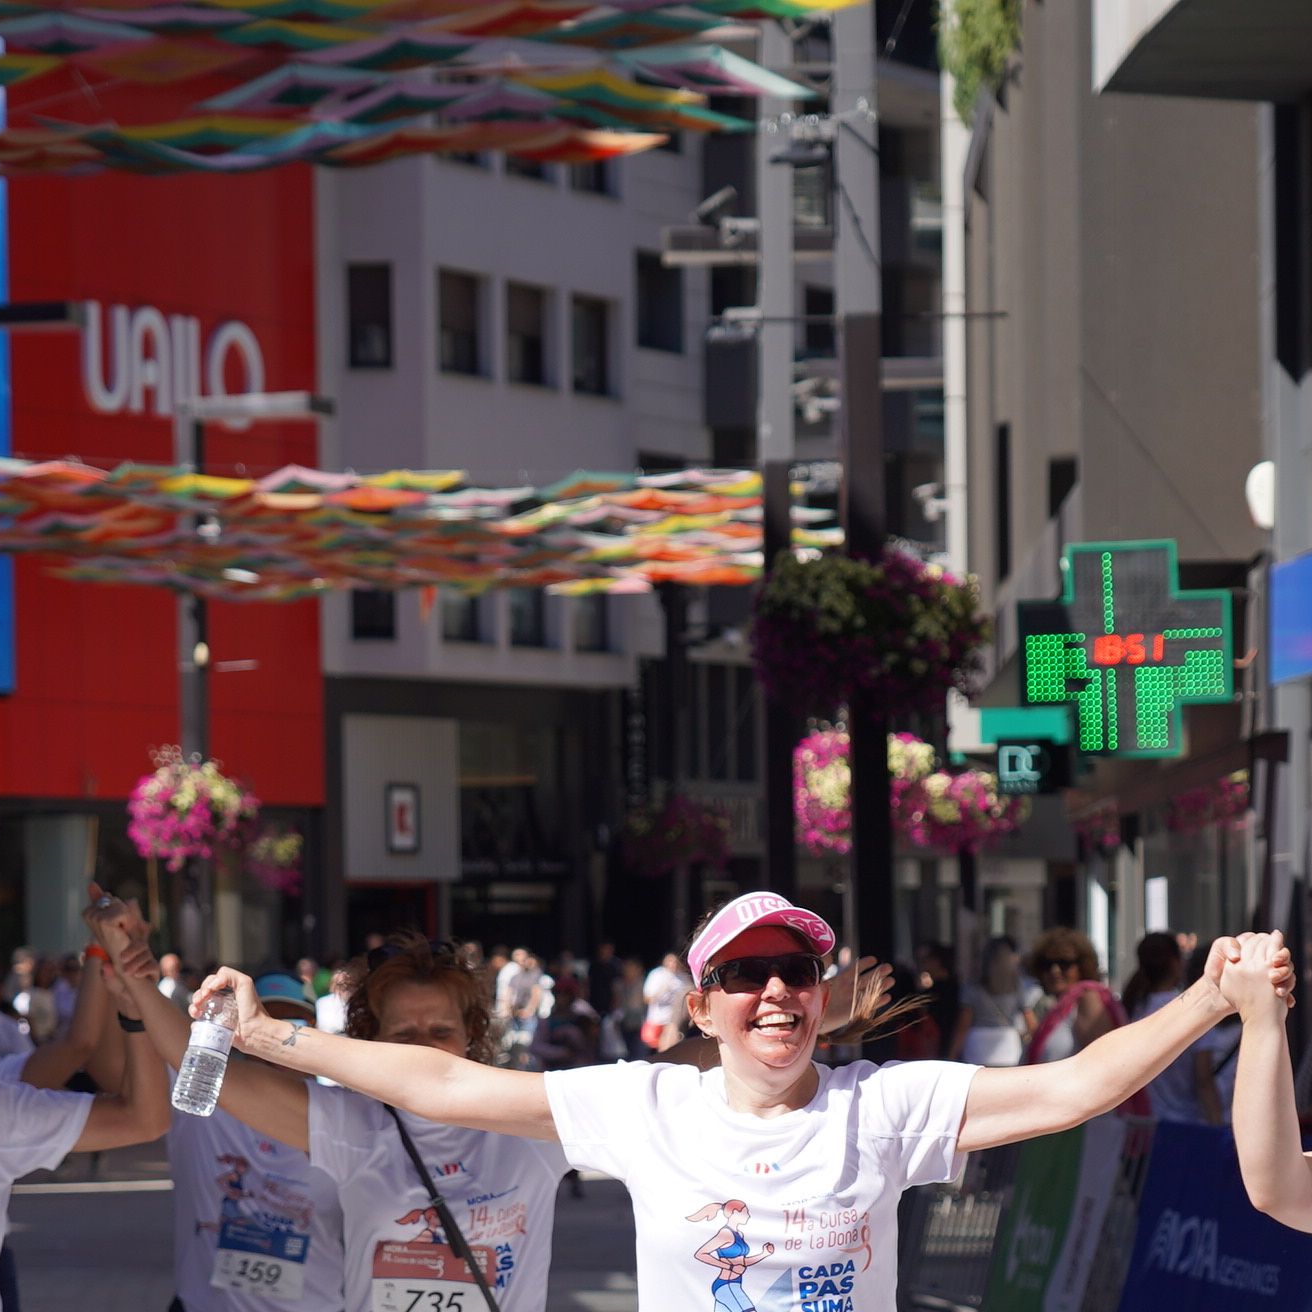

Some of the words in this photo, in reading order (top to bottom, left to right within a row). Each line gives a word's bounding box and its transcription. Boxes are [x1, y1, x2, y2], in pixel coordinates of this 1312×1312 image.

[819, 1208, 858, 1229] Cursa
[784, 1237, 803, 1250] de
[809, 1235, 825, 1250] la
[827, 1228, 859, 1248] Dona
[237, 1258, 282, 1286] 159
[798, 1259, 856, 1280] CADA
[798, 1275, 855, 1300] PAS
